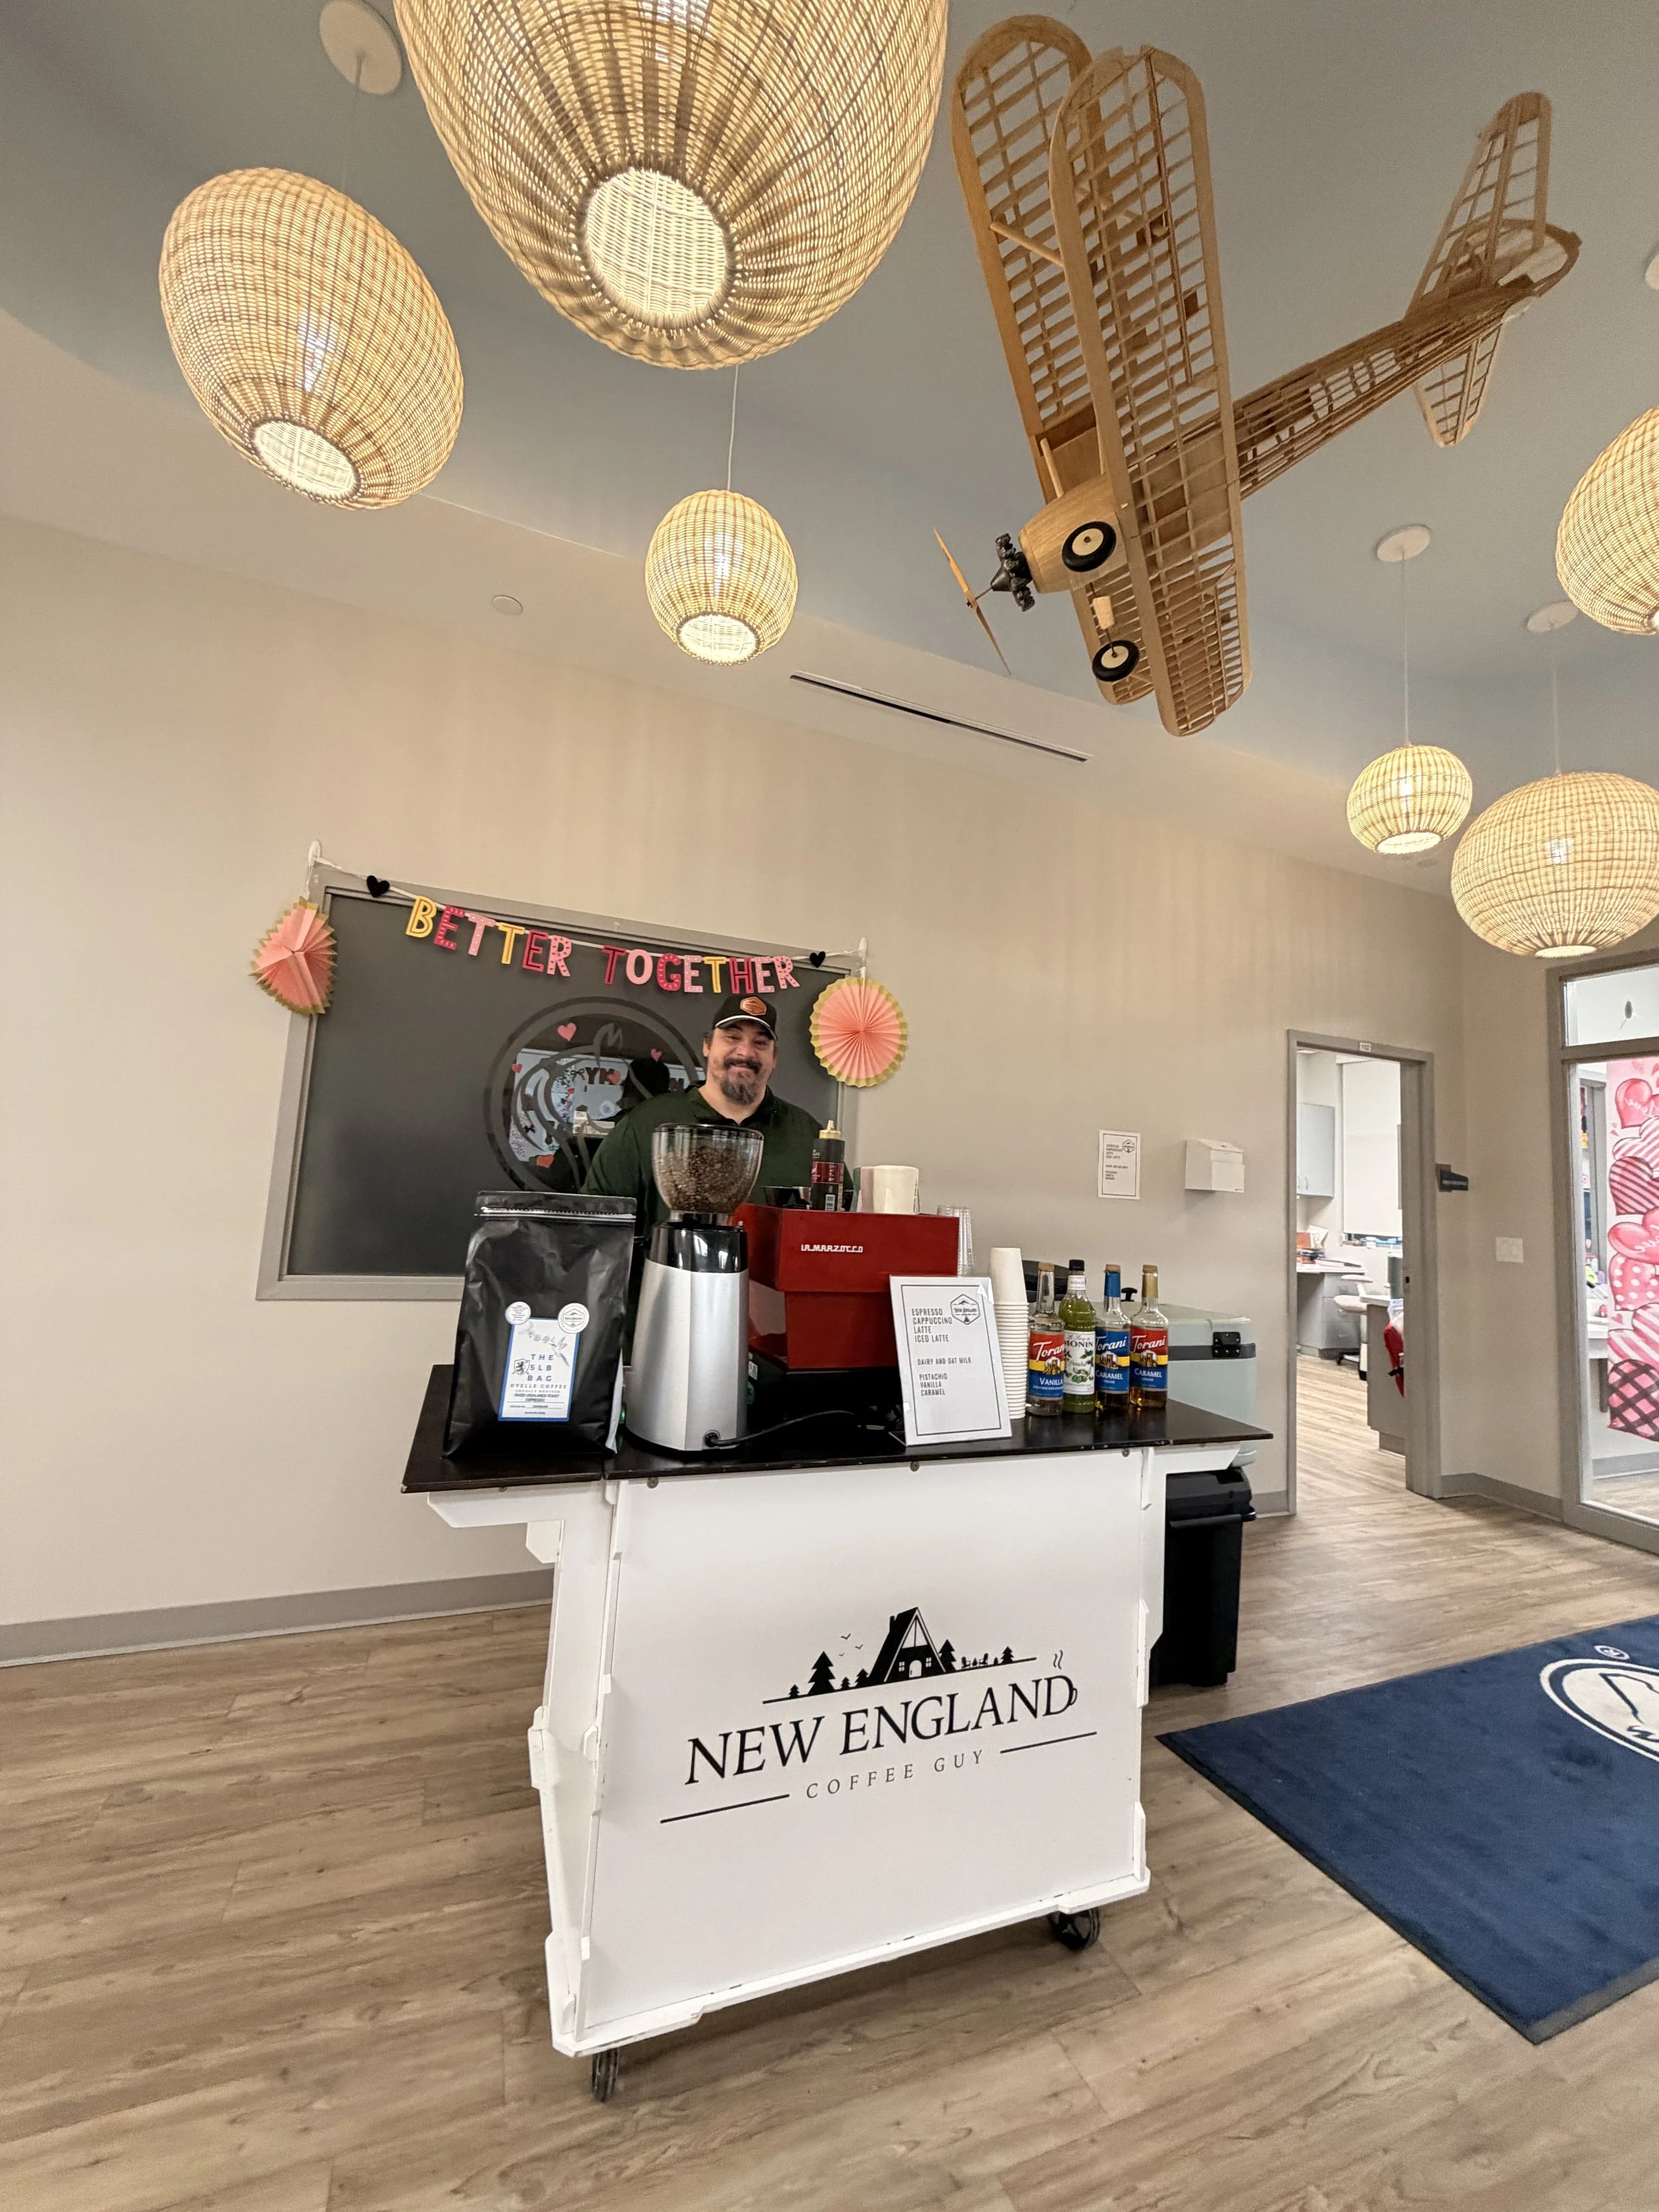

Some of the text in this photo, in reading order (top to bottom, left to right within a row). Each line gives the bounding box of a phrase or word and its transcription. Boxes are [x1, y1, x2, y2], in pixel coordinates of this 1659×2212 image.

[405, 896, 800, 994] BETTER TOGETHER
[1033, 1341, 1064, 1362] Toran
[1131, 1335, 1166, 1353] Torani
[1096, 1370, 1123, 1380] CARAMEL
[1134, 1368, 1163, 1378] CARAMEL
[685, 1674, 1078, 1785] NEW ENGLAND
[806, 1749, 985, 1799] COFFEE GUY
